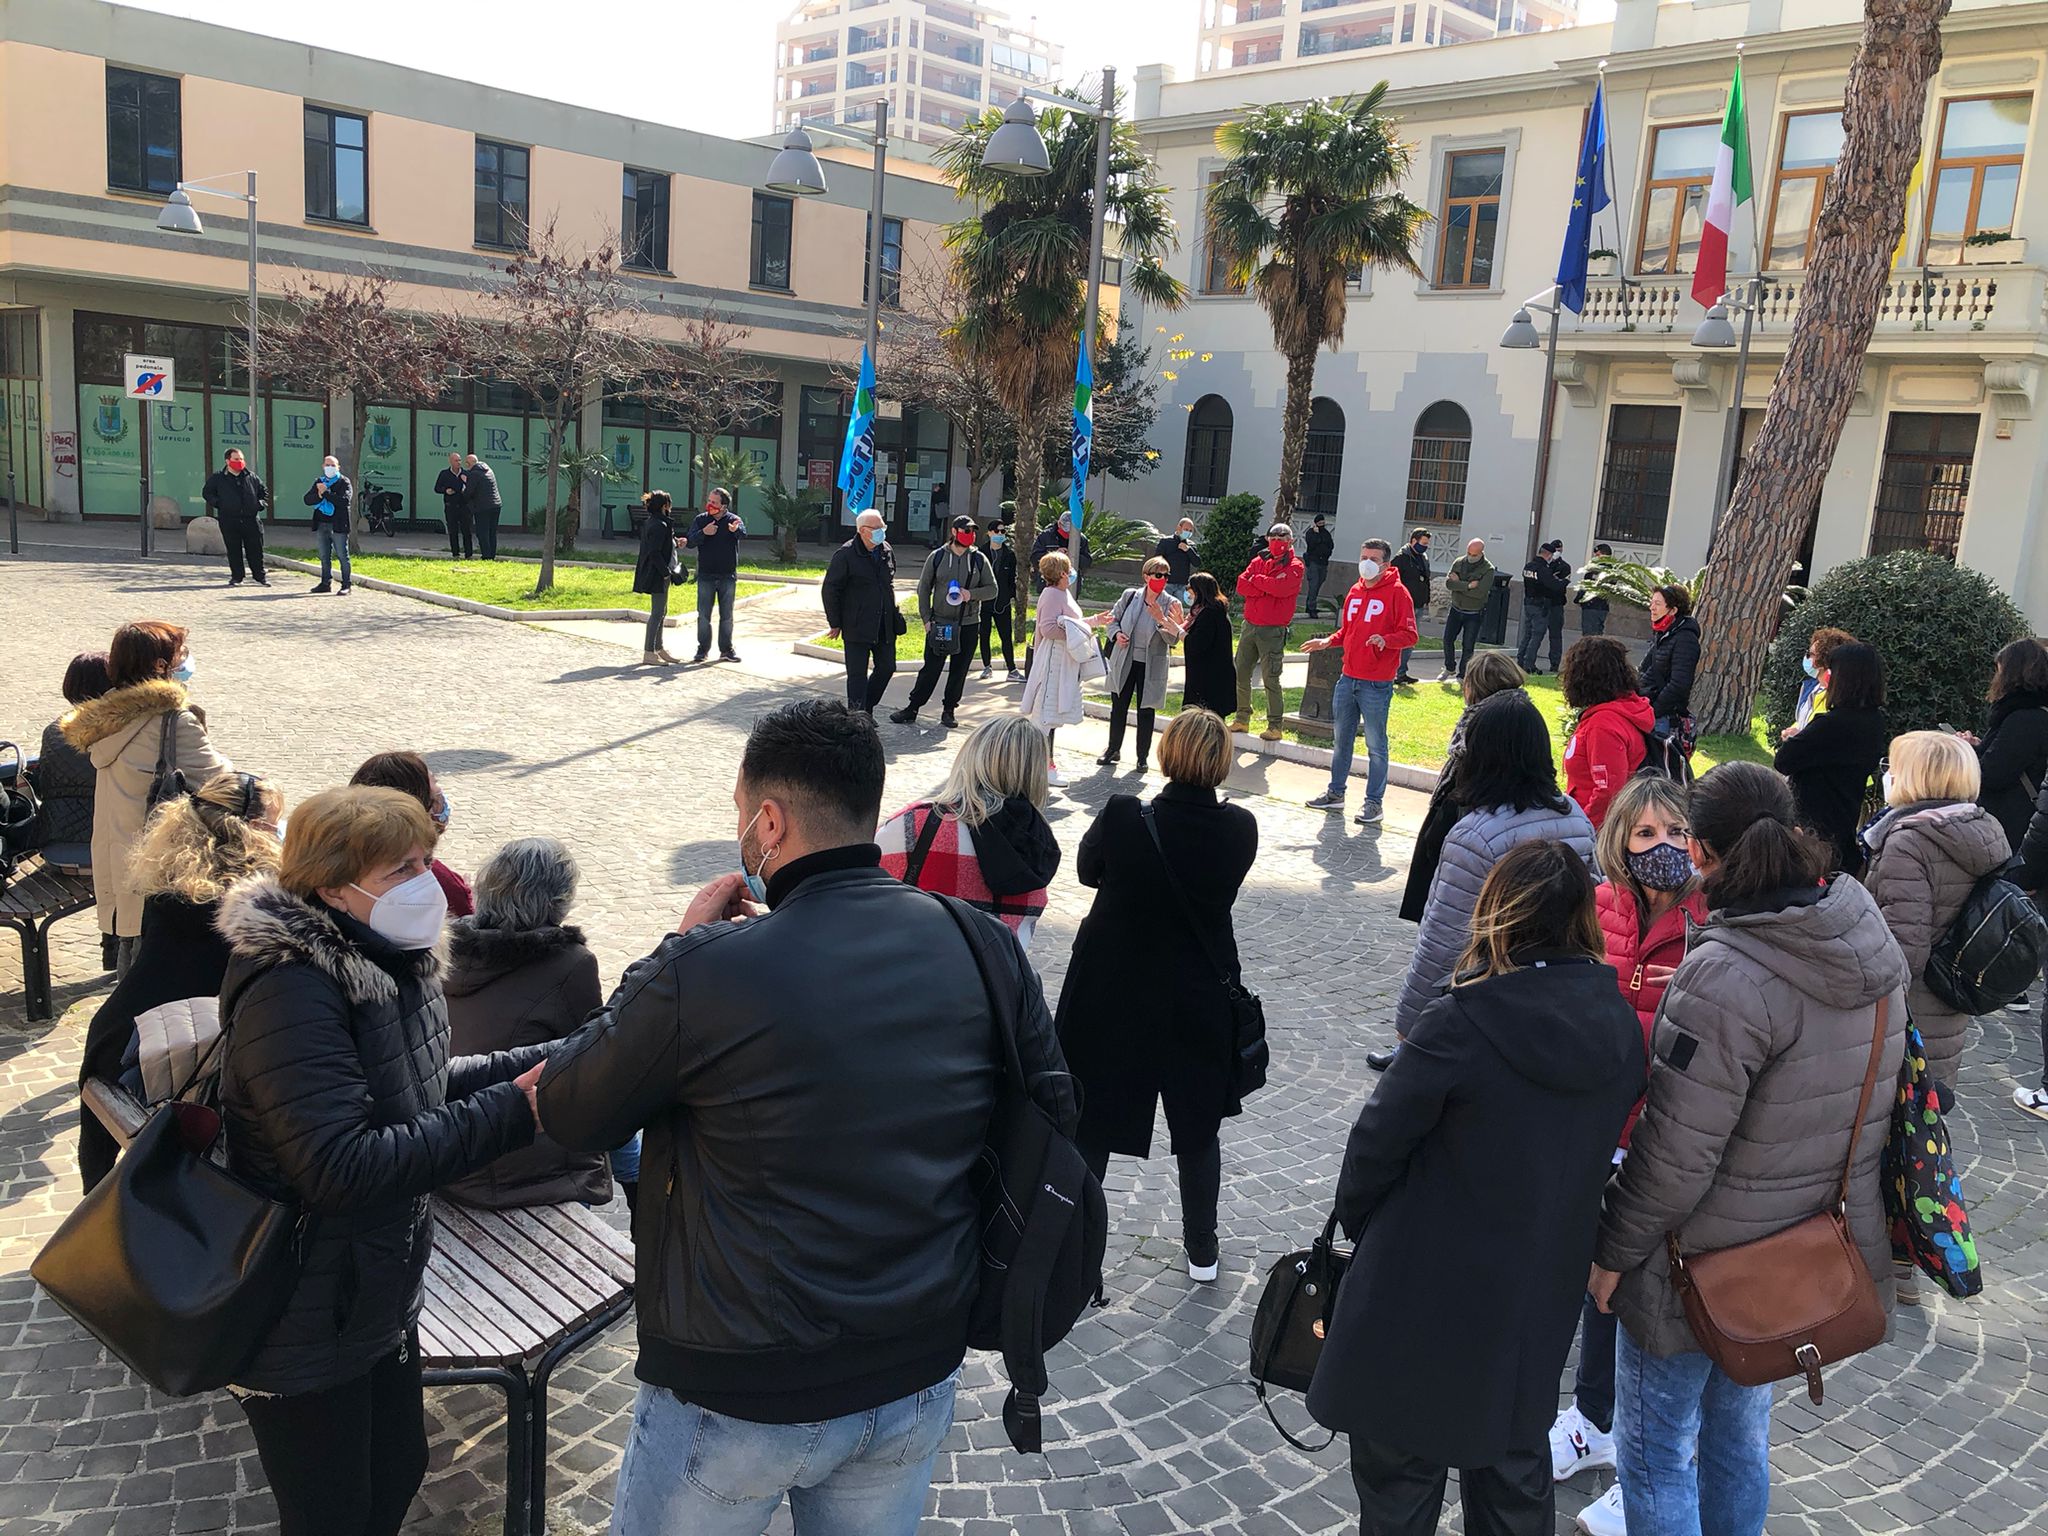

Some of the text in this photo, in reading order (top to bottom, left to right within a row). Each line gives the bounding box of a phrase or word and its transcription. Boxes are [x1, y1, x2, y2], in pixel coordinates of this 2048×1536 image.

[283, 414, 316, 440] P.
[427, 423, 458, 448] U.
[483, 427, 516, 452] R.
